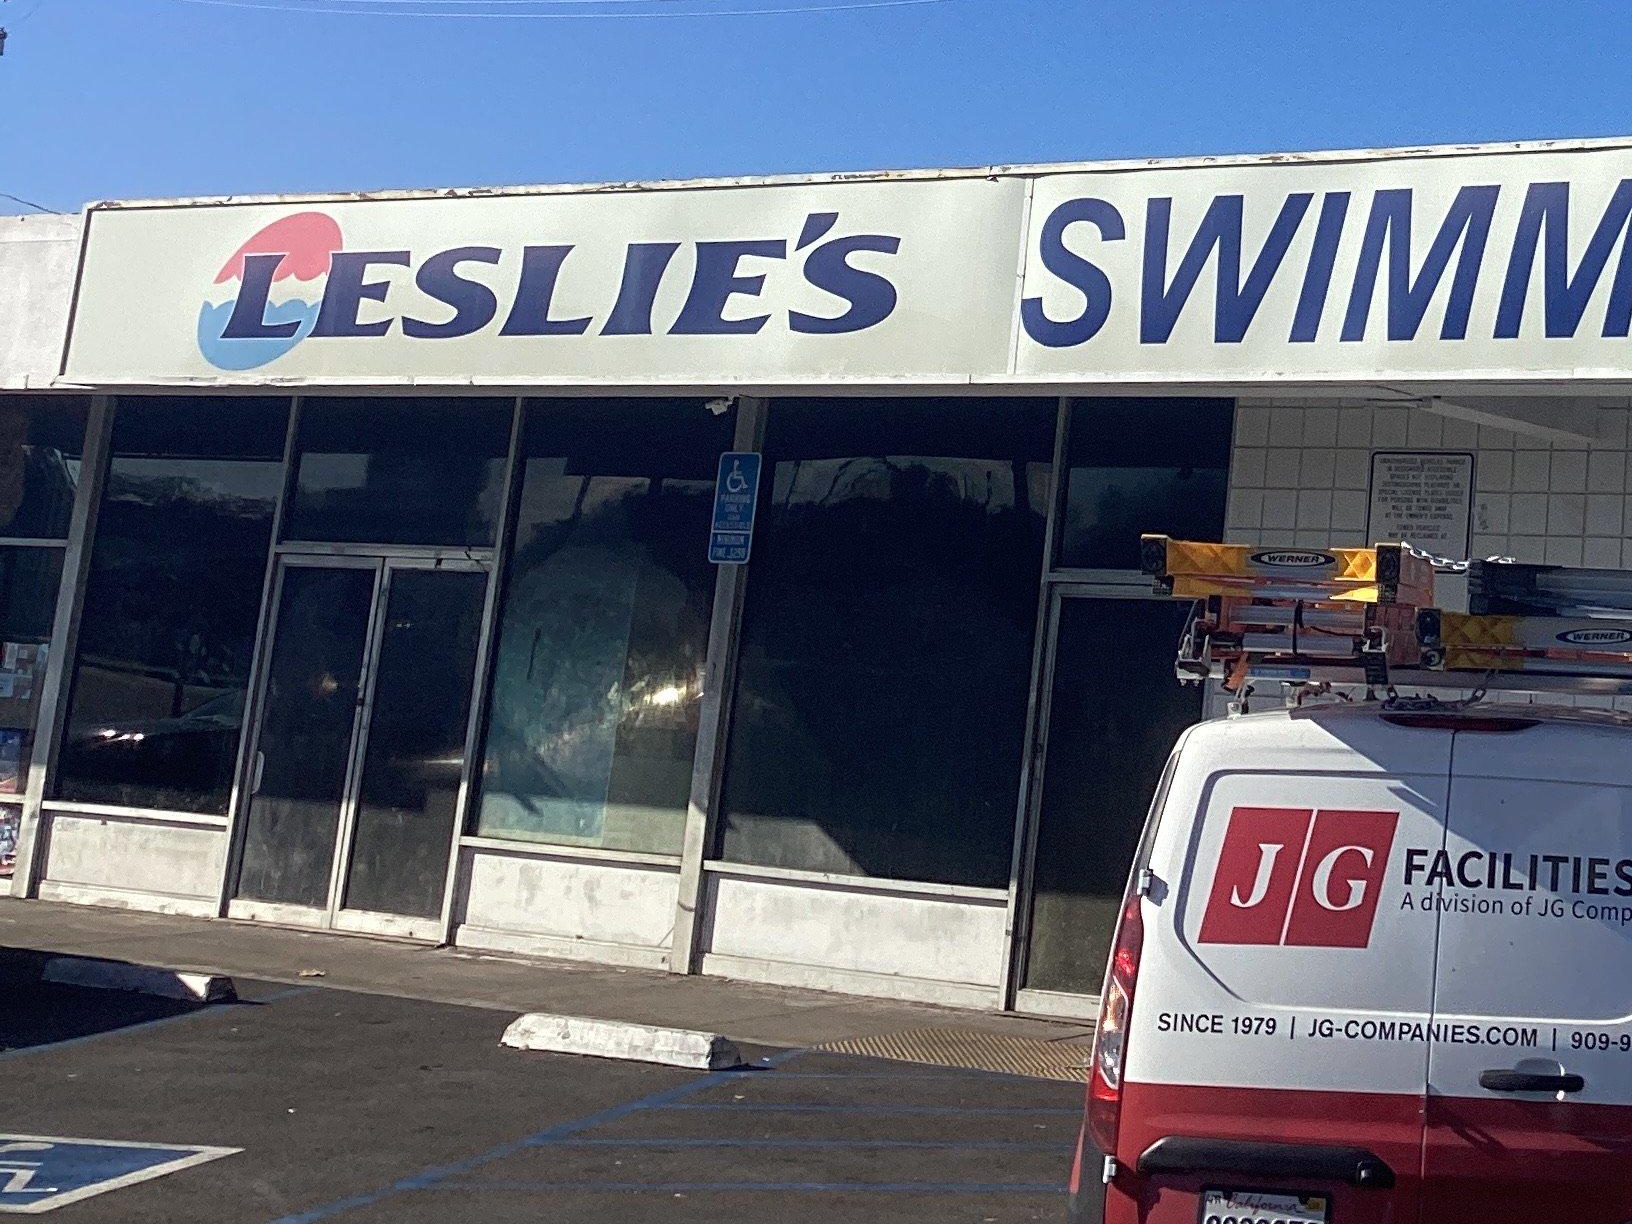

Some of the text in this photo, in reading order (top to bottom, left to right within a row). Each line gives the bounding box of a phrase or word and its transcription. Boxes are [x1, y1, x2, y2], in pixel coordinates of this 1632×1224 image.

[219, 211, 901, 339] LESLIE'S
[1267, 554, 1319, 564] WERNER
[1573, 631, 1625, 642] WERNER
[1400, 891, 1415, 911] A
[1420, 891, 1504, 915] division
[1510, 895, 1535, 916] of
[1537, 898, 1566, 919] JG
[1157, 1012, 1224, 1034] SINCE
[1231, 1016, 1277, 1036] 1979
[1308, 1018, 1538, 1048] JG-COMPANIES.COM
